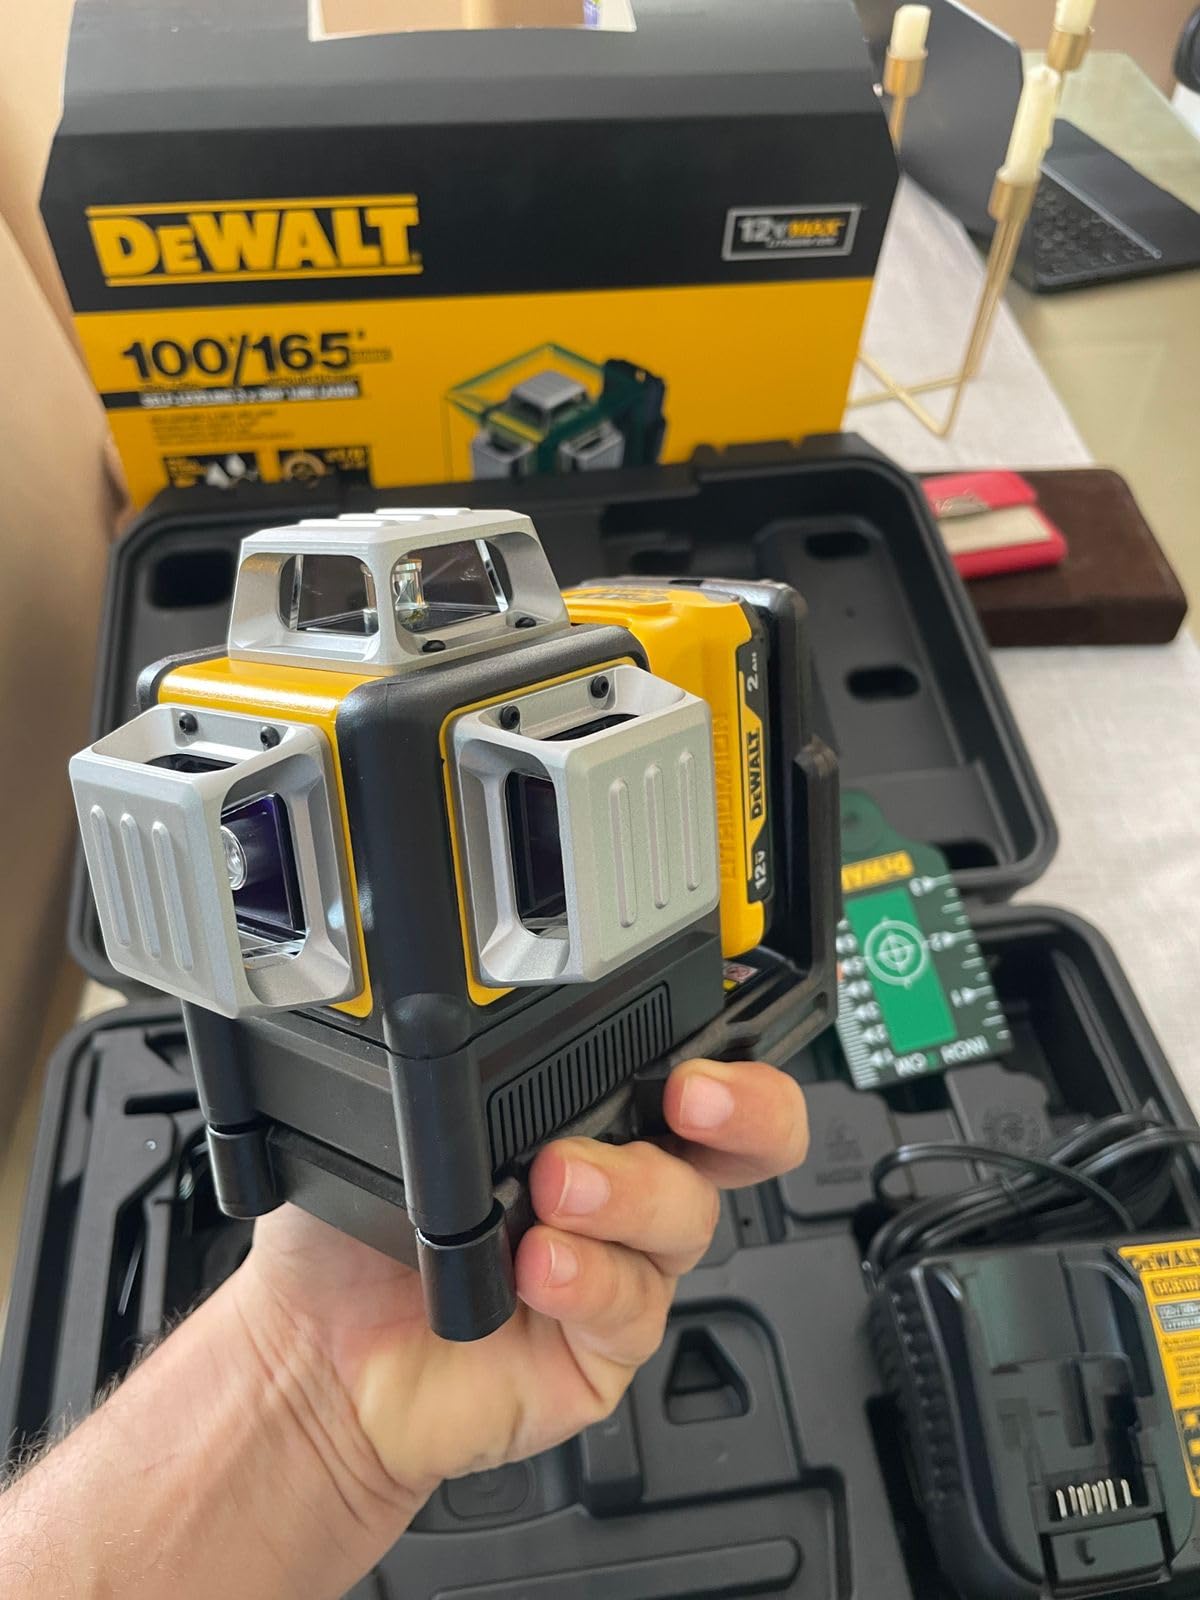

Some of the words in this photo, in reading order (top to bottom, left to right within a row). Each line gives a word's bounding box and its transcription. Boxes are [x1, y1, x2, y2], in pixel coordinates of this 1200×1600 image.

[88, 206, 419, 277] DEWALT
[747, 727, 764, 820] DEWALT
[754, 850, 767, 890] 12V
